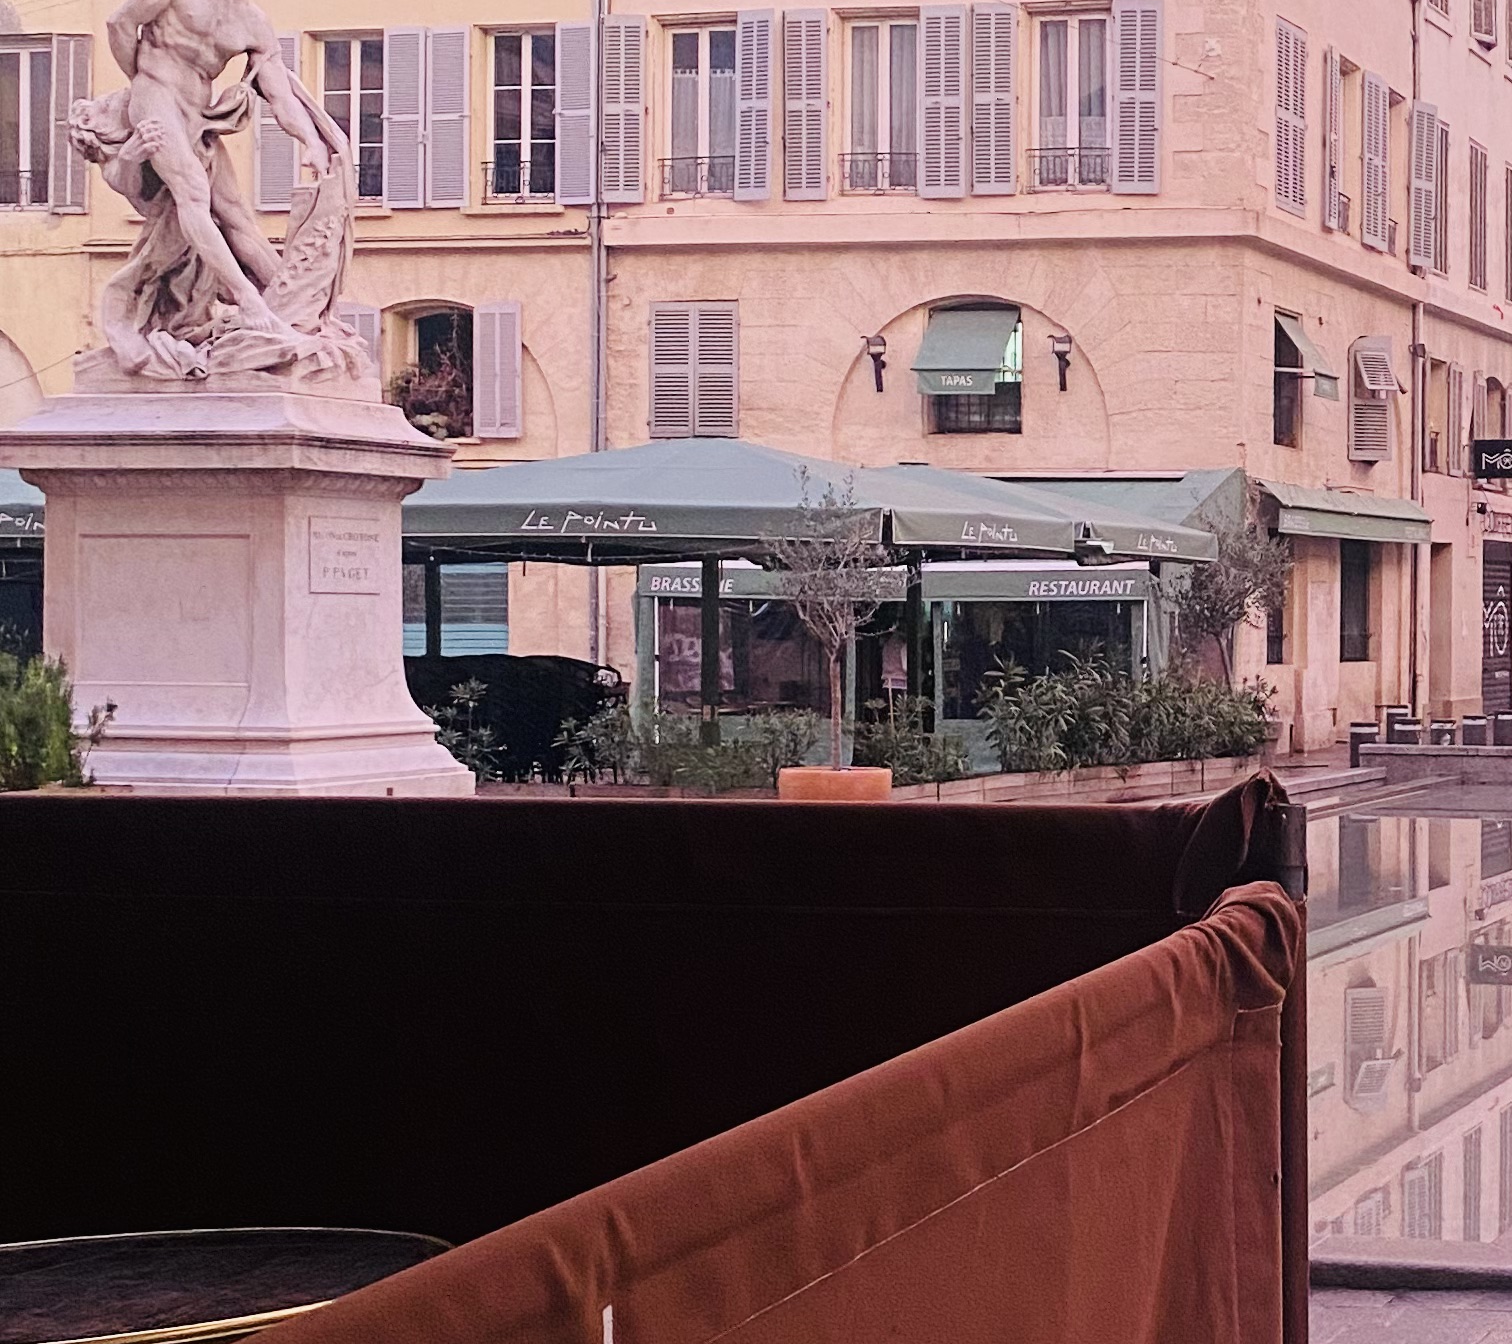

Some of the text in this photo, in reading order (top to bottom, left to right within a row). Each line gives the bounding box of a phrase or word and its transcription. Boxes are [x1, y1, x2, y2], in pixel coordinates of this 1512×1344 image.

[941, 376, 973, 386] TAPAS
[650, 576, 734, 593] BRASSIE
[1029, 580, 1135, 596] RESTAURANT
